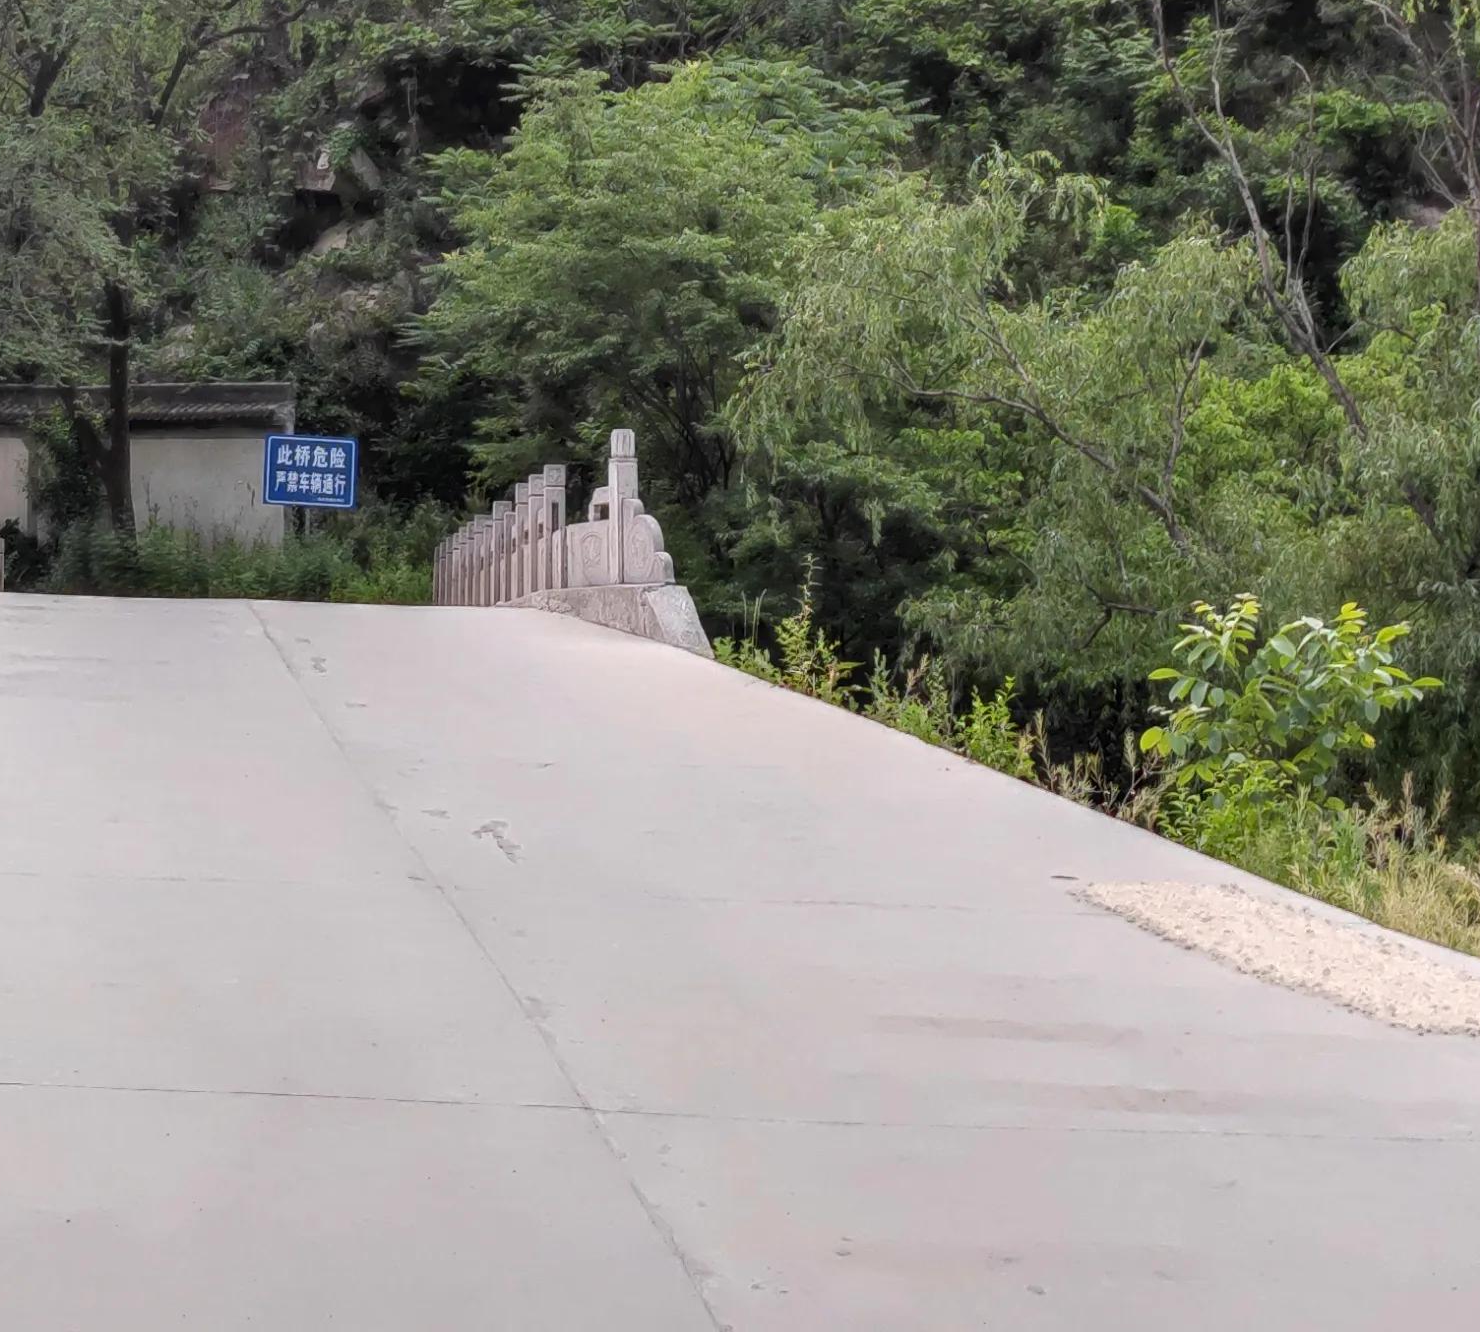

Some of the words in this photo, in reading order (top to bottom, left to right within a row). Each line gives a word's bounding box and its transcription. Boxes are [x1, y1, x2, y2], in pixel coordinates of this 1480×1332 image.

[276, 444, 346, 468] 此桥危险
[275, 470, 346, 496] 严禁车辆通行
